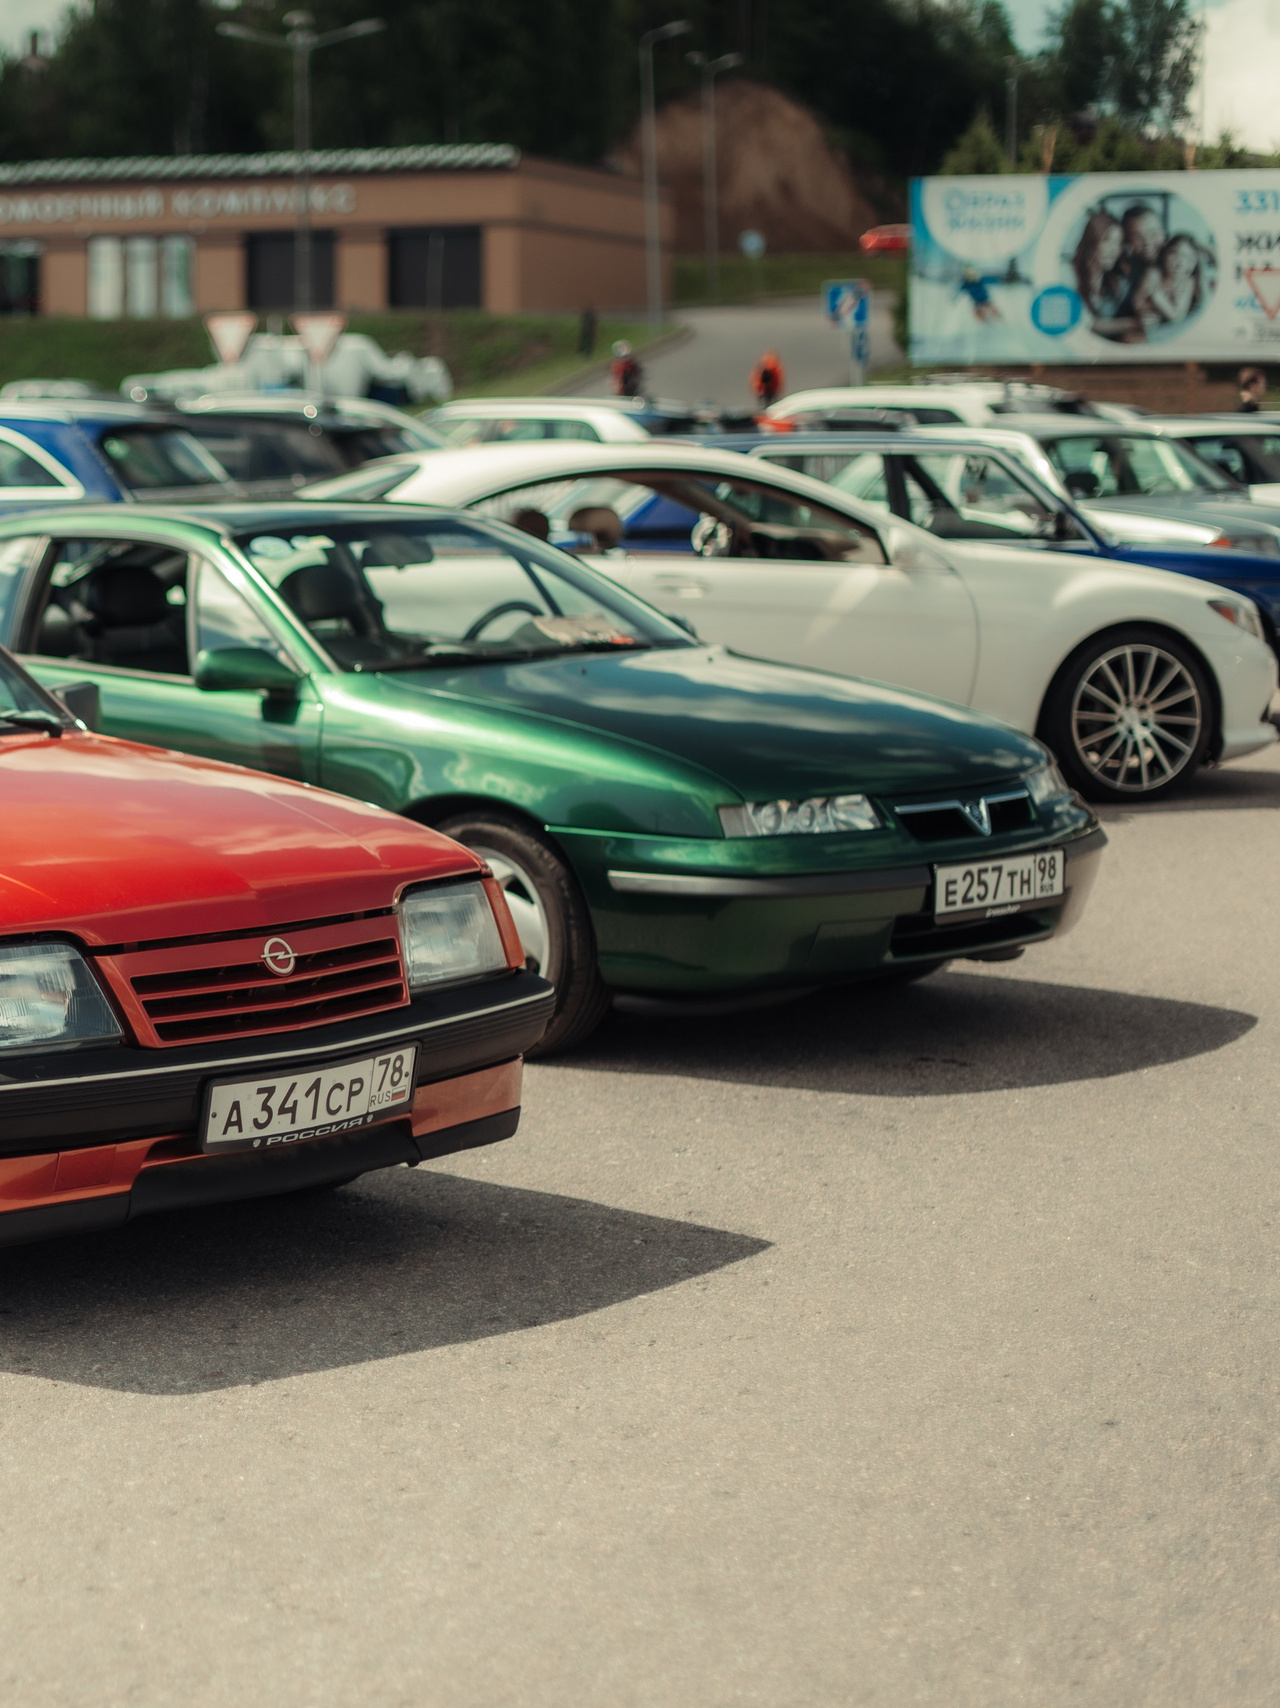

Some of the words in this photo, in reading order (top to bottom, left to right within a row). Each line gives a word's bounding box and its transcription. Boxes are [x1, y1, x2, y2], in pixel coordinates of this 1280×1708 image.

[1038, 855, 1056, 882] 98
[377, 1054, 405, 1092] 78
[370, 1090, 391, 1108] RUS
[266, 1117, 363, 1146] РОССИЯ
